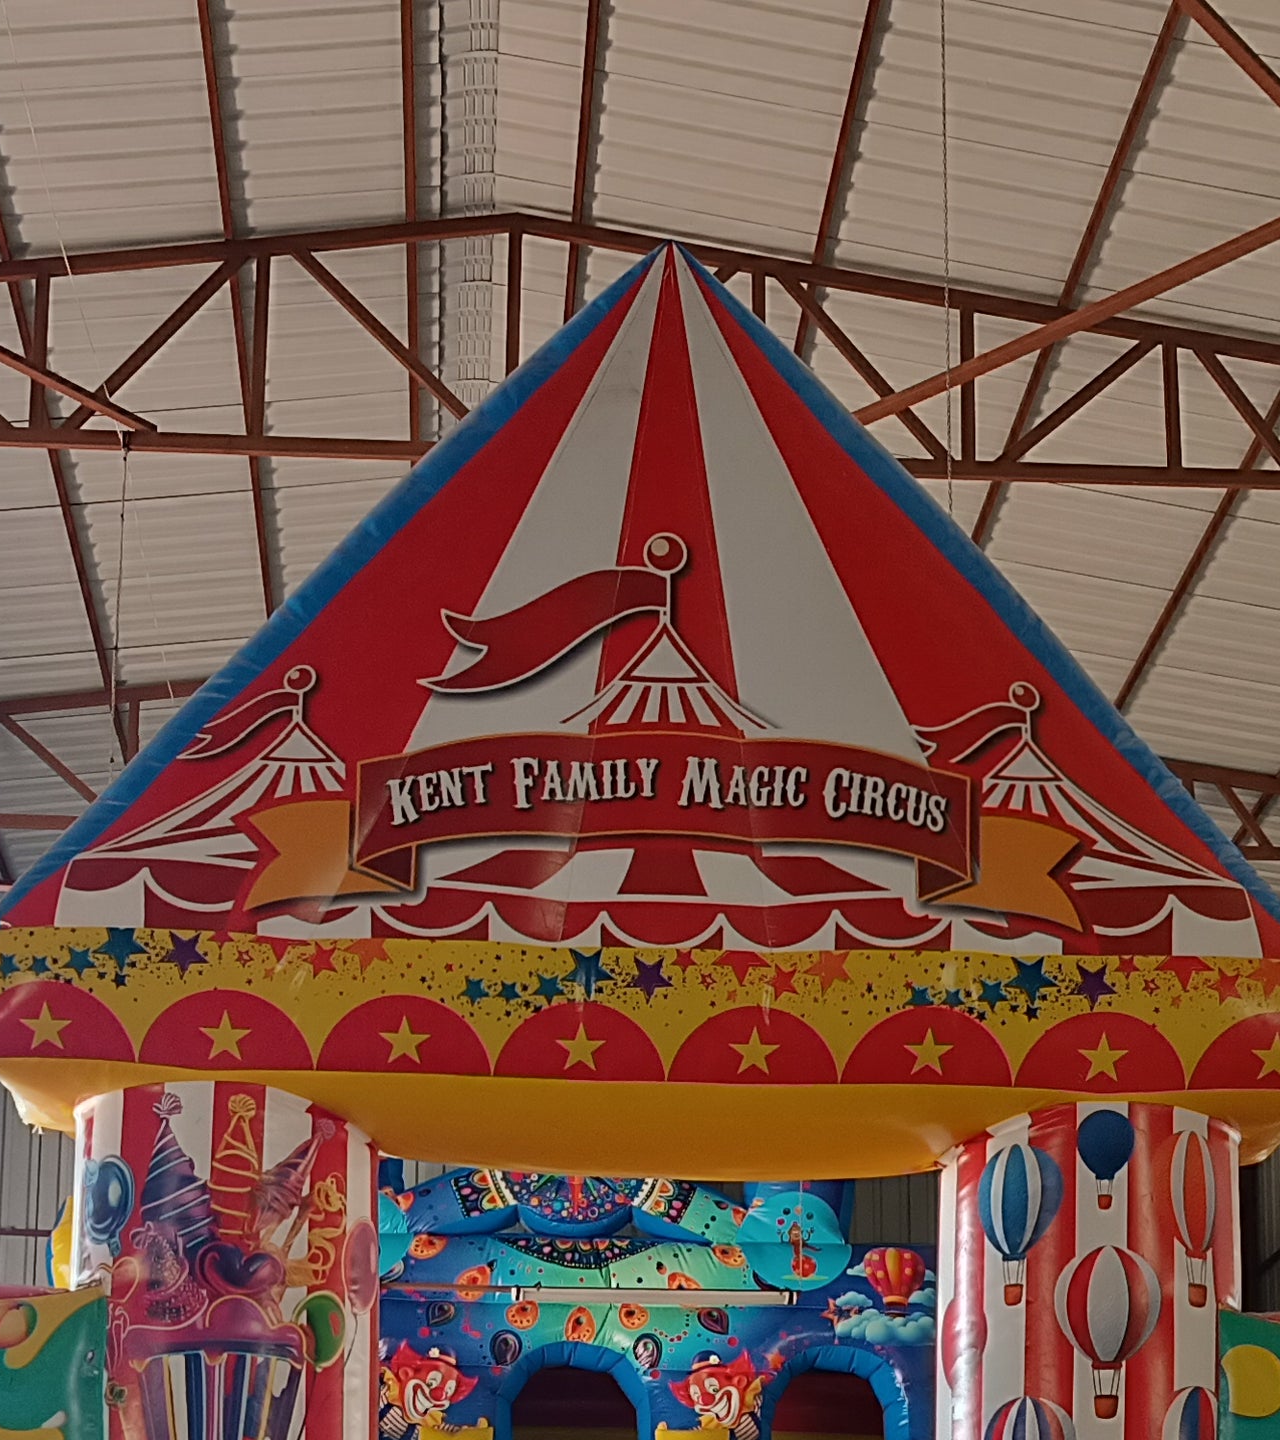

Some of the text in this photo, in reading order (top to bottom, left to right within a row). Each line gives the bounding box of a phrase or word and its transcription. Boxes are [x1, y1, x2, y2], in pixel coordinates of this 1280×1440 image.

[384, 755, 948, 834] KENT FAMILY MAGIC CIRCUS
